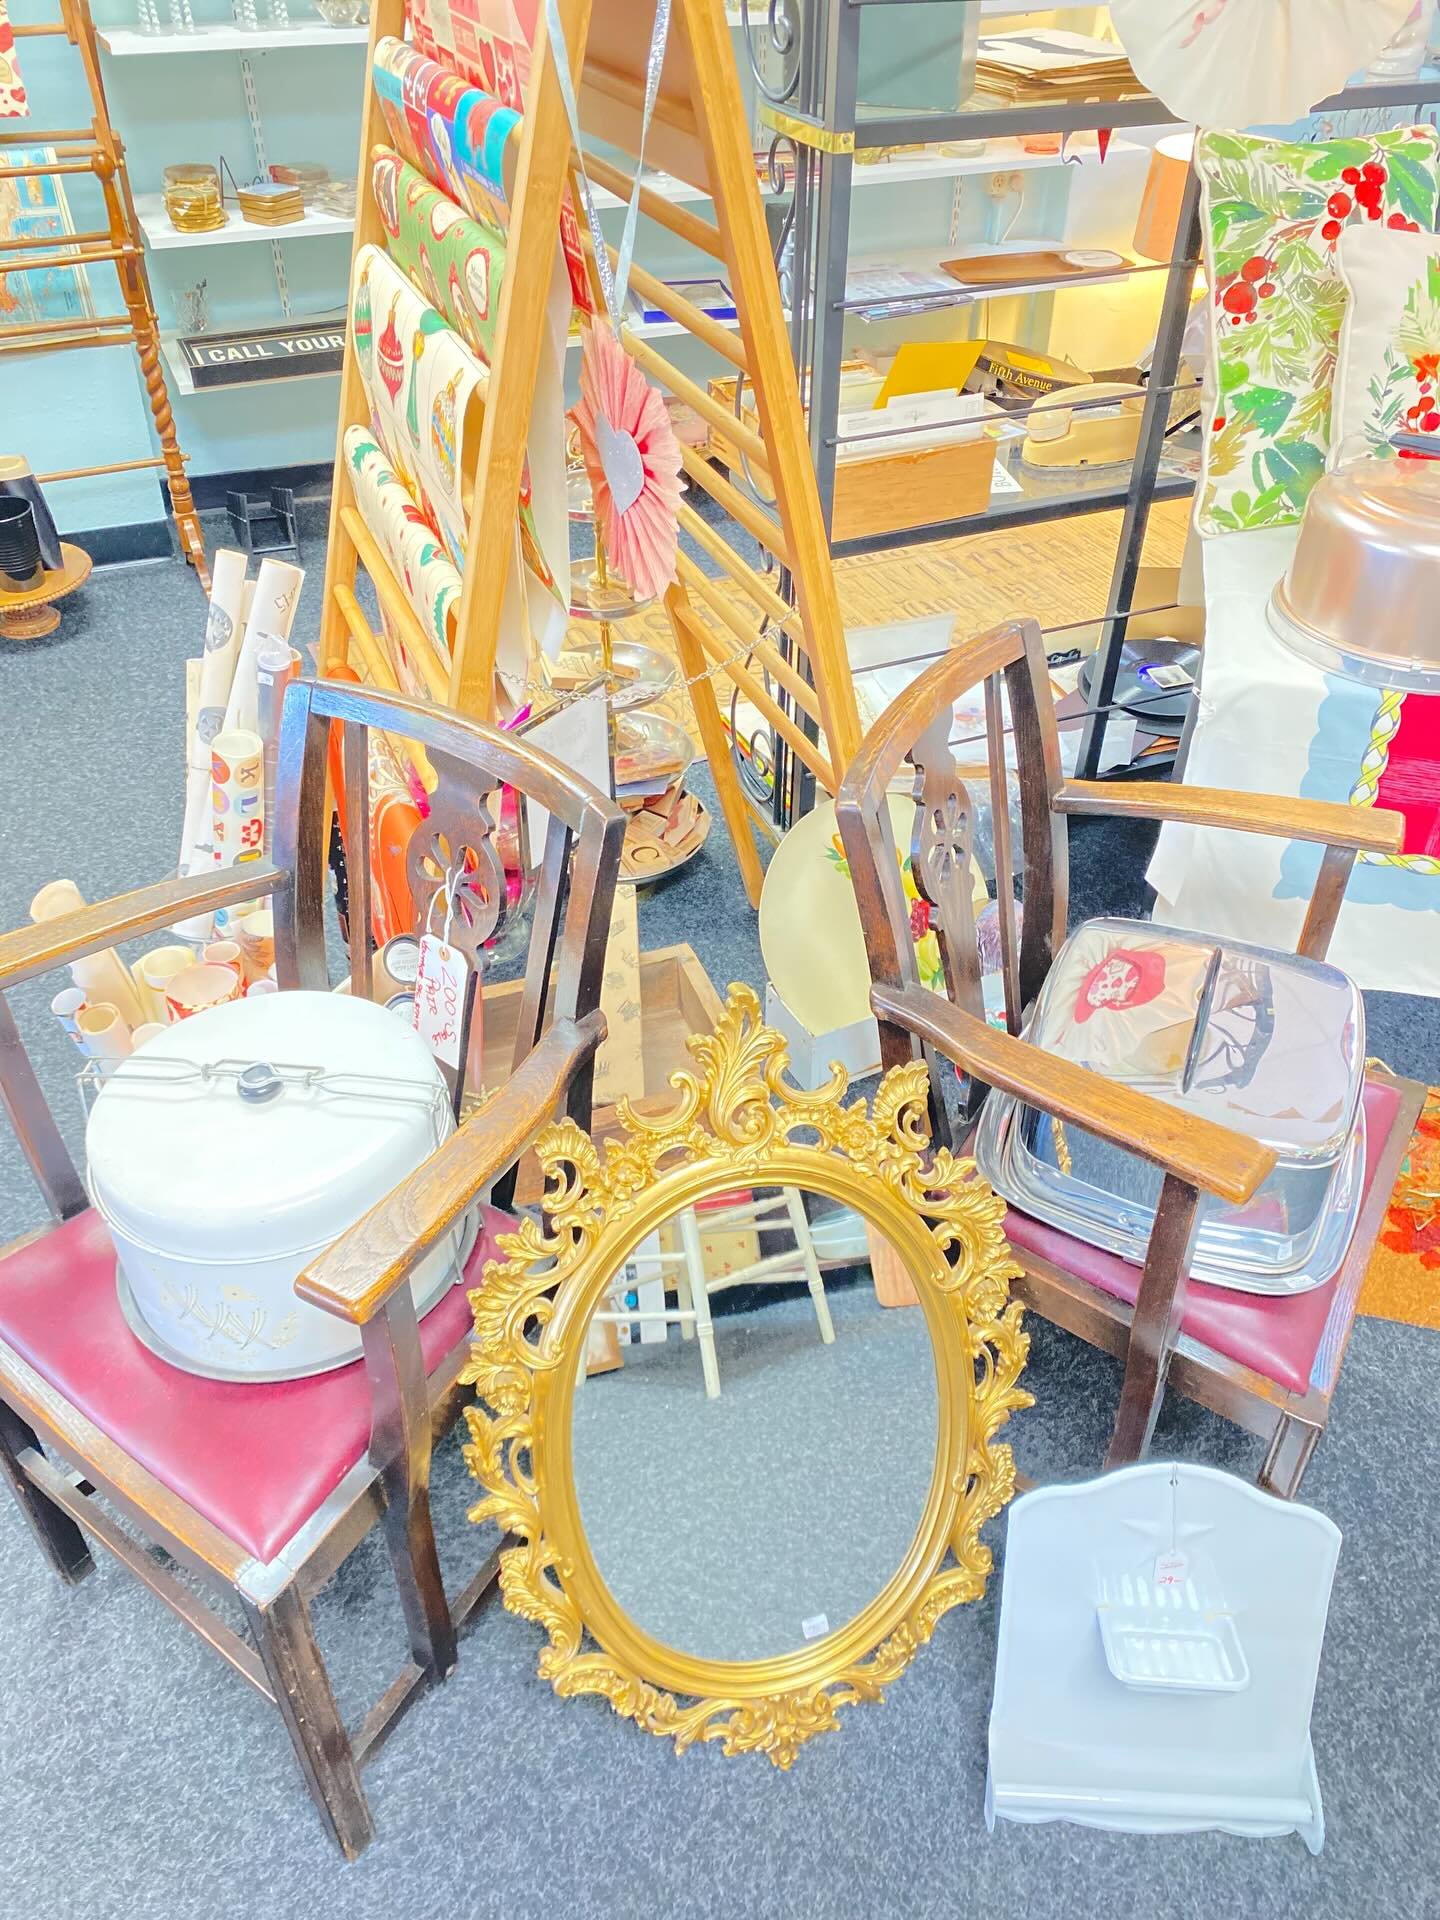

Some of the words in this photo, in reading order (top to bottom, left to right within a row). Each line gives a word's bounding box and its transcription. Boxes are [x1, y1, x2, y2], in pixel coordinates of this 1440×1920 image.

[208, 344, 273, 362] CALL
[279, 335, 345, 353] YOUR
[988, 361, 1013, 380] Fifth
[1015, 372, 1052, 391] Avenue
